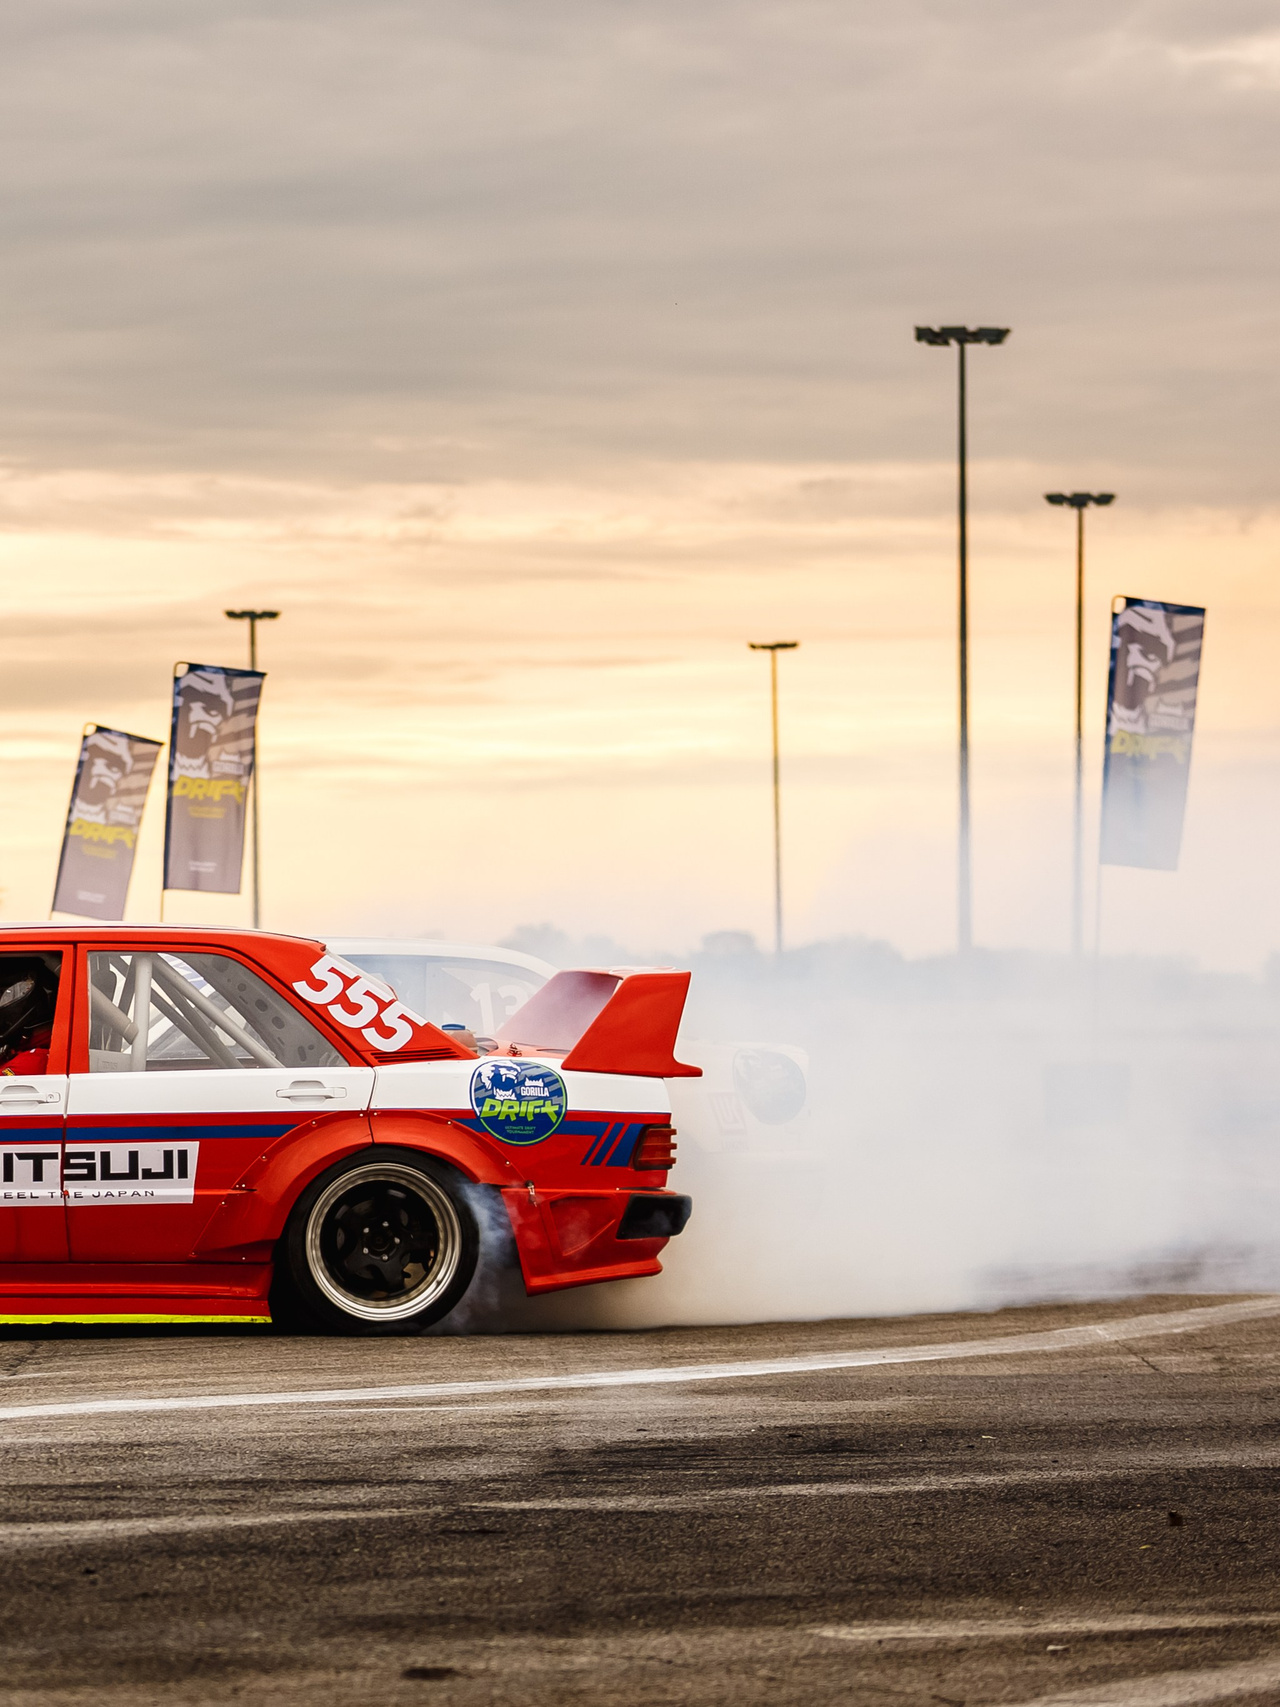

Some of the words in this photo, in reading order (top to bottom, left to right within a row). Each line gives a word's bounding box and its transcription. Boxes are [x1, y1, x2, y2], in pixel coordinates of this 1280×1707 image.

[292, 954, 429, 1052] 555
[520, 1087, 549, 1097] GORILLA
[480, 1098, 559, 1123] DRIFT
[47, 1191, 84, 1199] THE
[91, 1190, 155, 1199] JAPAN
